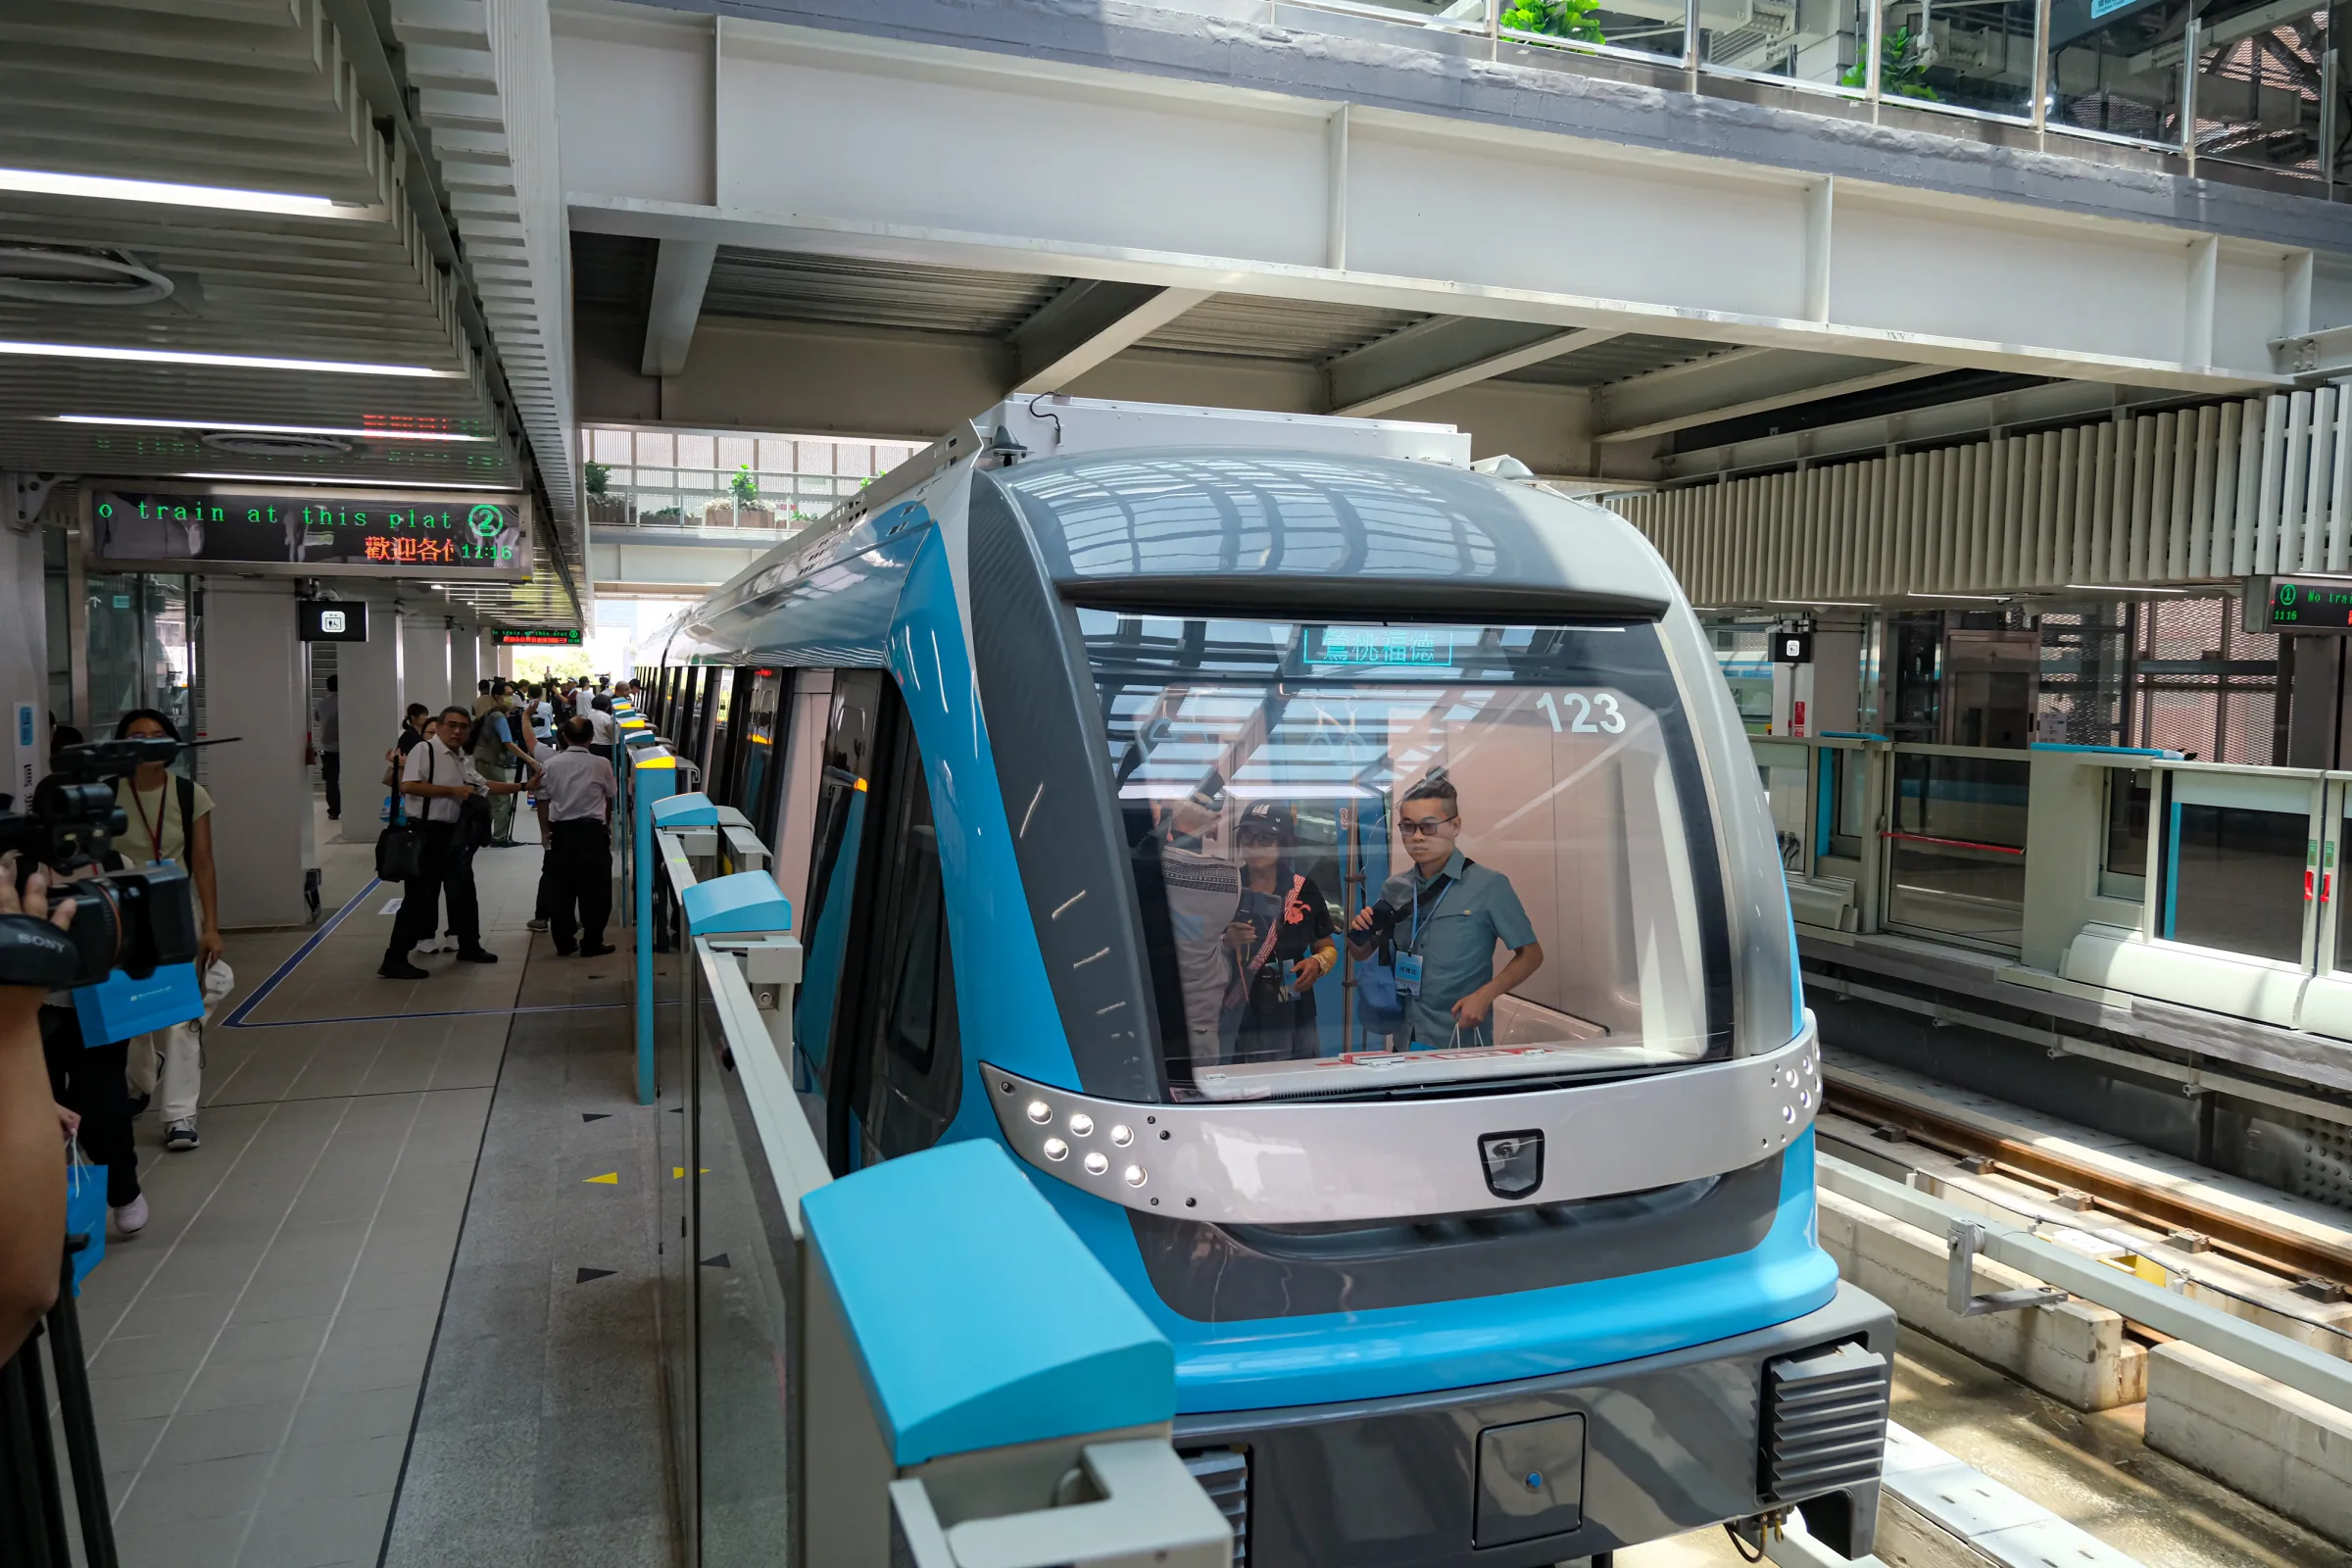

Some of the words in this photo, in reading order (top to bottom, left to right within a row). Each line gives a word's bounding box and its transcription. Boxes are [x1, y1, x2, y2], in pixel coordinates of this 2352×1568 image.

[138, 501, 224, 521] train
[247, 505, 277, 523] at
[303, 507, 367, 526] this
[389, 509, 451, 528] plat
[463, 544, 512, 560] 11:16
[2308, 590, 2321, 603] No
[1323, 630, 1435, 662] 鶯桃福德
[1536, 692, 1626, 734] 123
[18, 933, 66, 953] SONY
